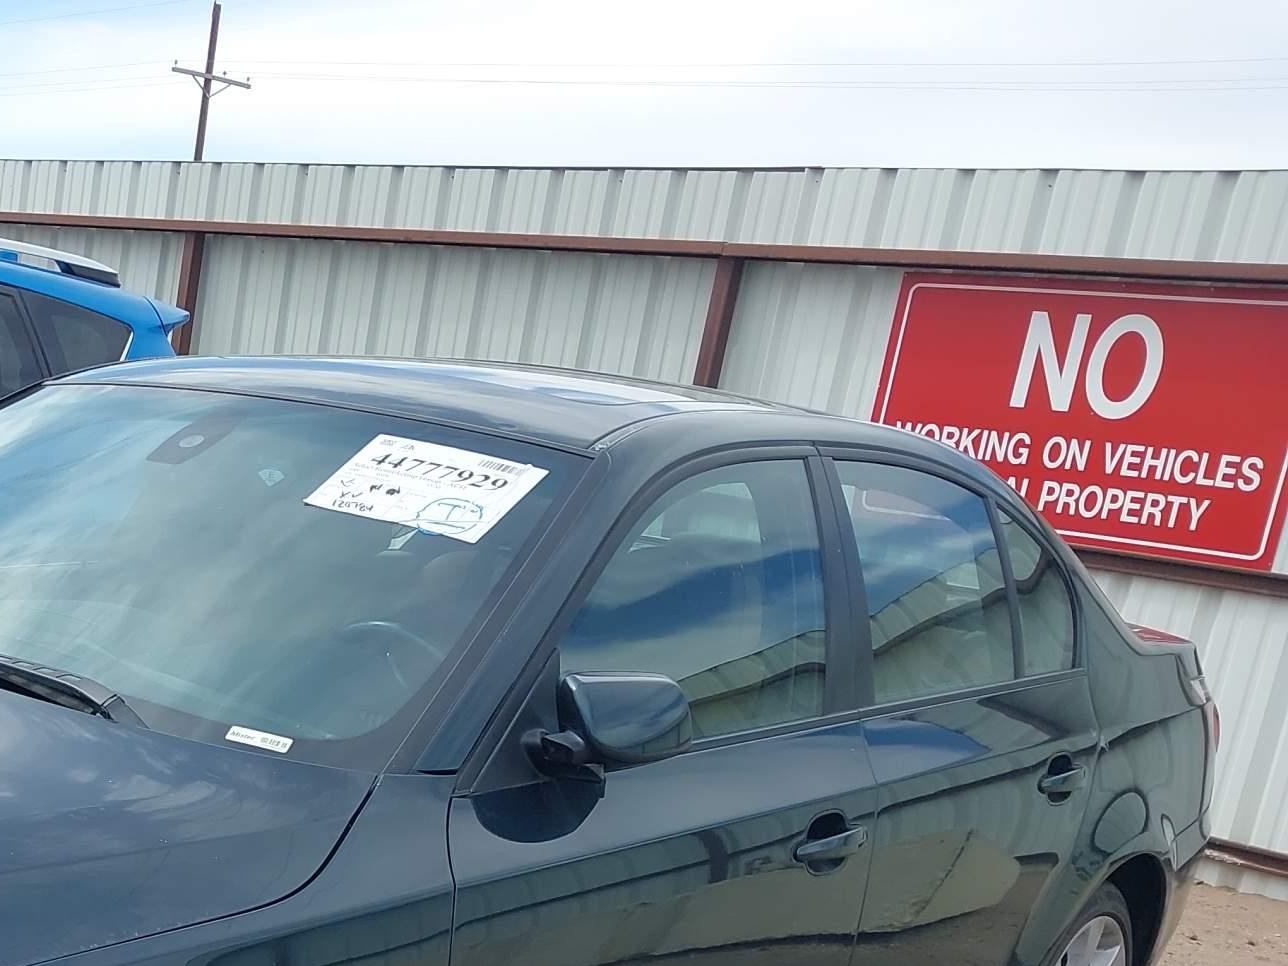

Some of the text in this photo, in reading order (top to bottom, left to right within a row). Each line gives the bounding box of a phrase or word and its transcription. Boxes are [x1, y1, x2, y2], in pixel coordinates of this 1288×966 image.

[1009, 310, 1165, 420] NO
[370, 453, 509, 491] 44777929
[1042, 436, 1092, 471] ON
[1104, 441, 1264, 492] VEHICLES
[1037, 480, 1212, 531] PROPERTY
